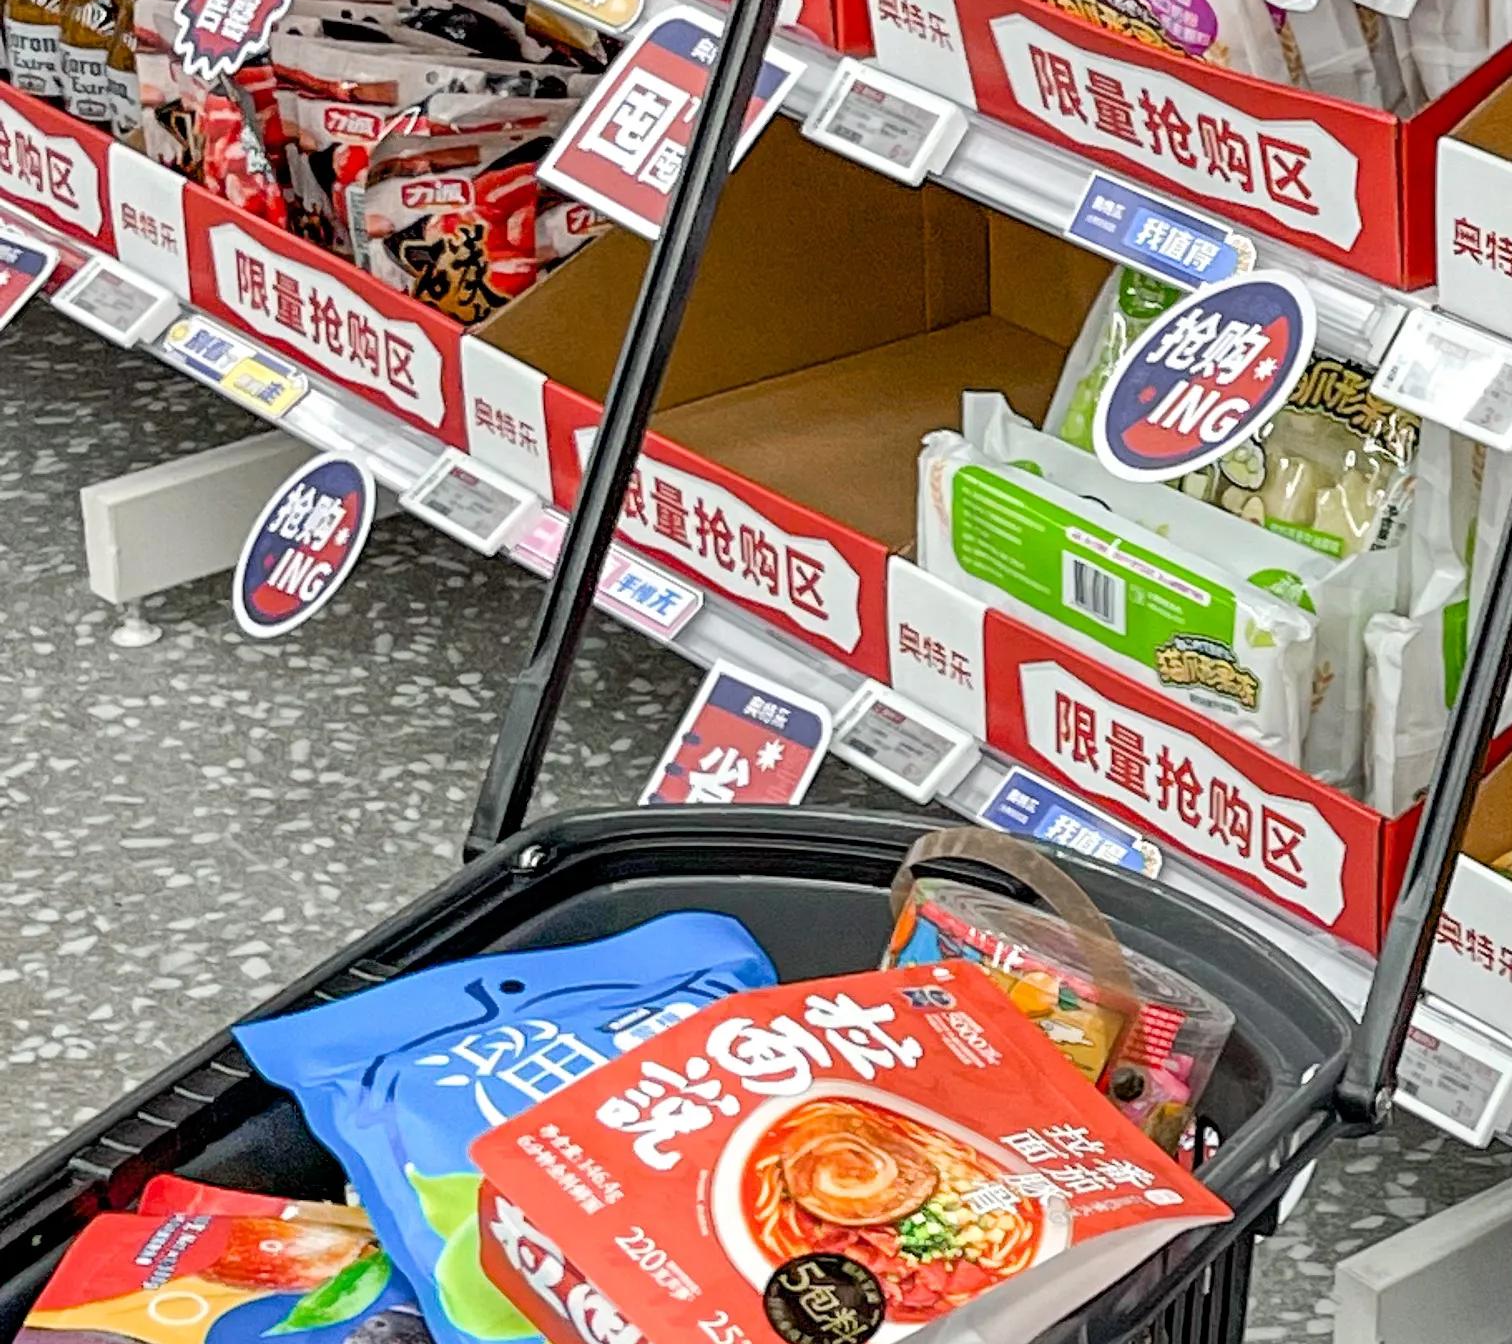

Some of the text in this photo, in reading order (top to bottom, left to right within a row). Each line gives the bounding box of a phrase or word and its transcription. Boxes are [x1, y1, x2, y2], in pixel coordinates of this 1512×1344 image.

[1029, 43, 1320, 217] 限量抢购区
[121, 202, 178, 256] 奥特乐
[1135, 217, 1222, 275] 我值得
[235, 250, 419, 400] 限量抢购区
[1145, 307, 1272, 389] 抢购
[474, 396, 539, 456] 奥特乐
[1145, 380, 1250, 446] ING
[269, 483, 348, 551] 抢购
[268, 547, 332, 603] ING
[615, 573, 683, 615] 手慢无
[899, 622, 975, 689] 奥特乐
[1055, 690, 1308, 889] 限量抢购区
[1044, 812, 1129, 864] 我值得
